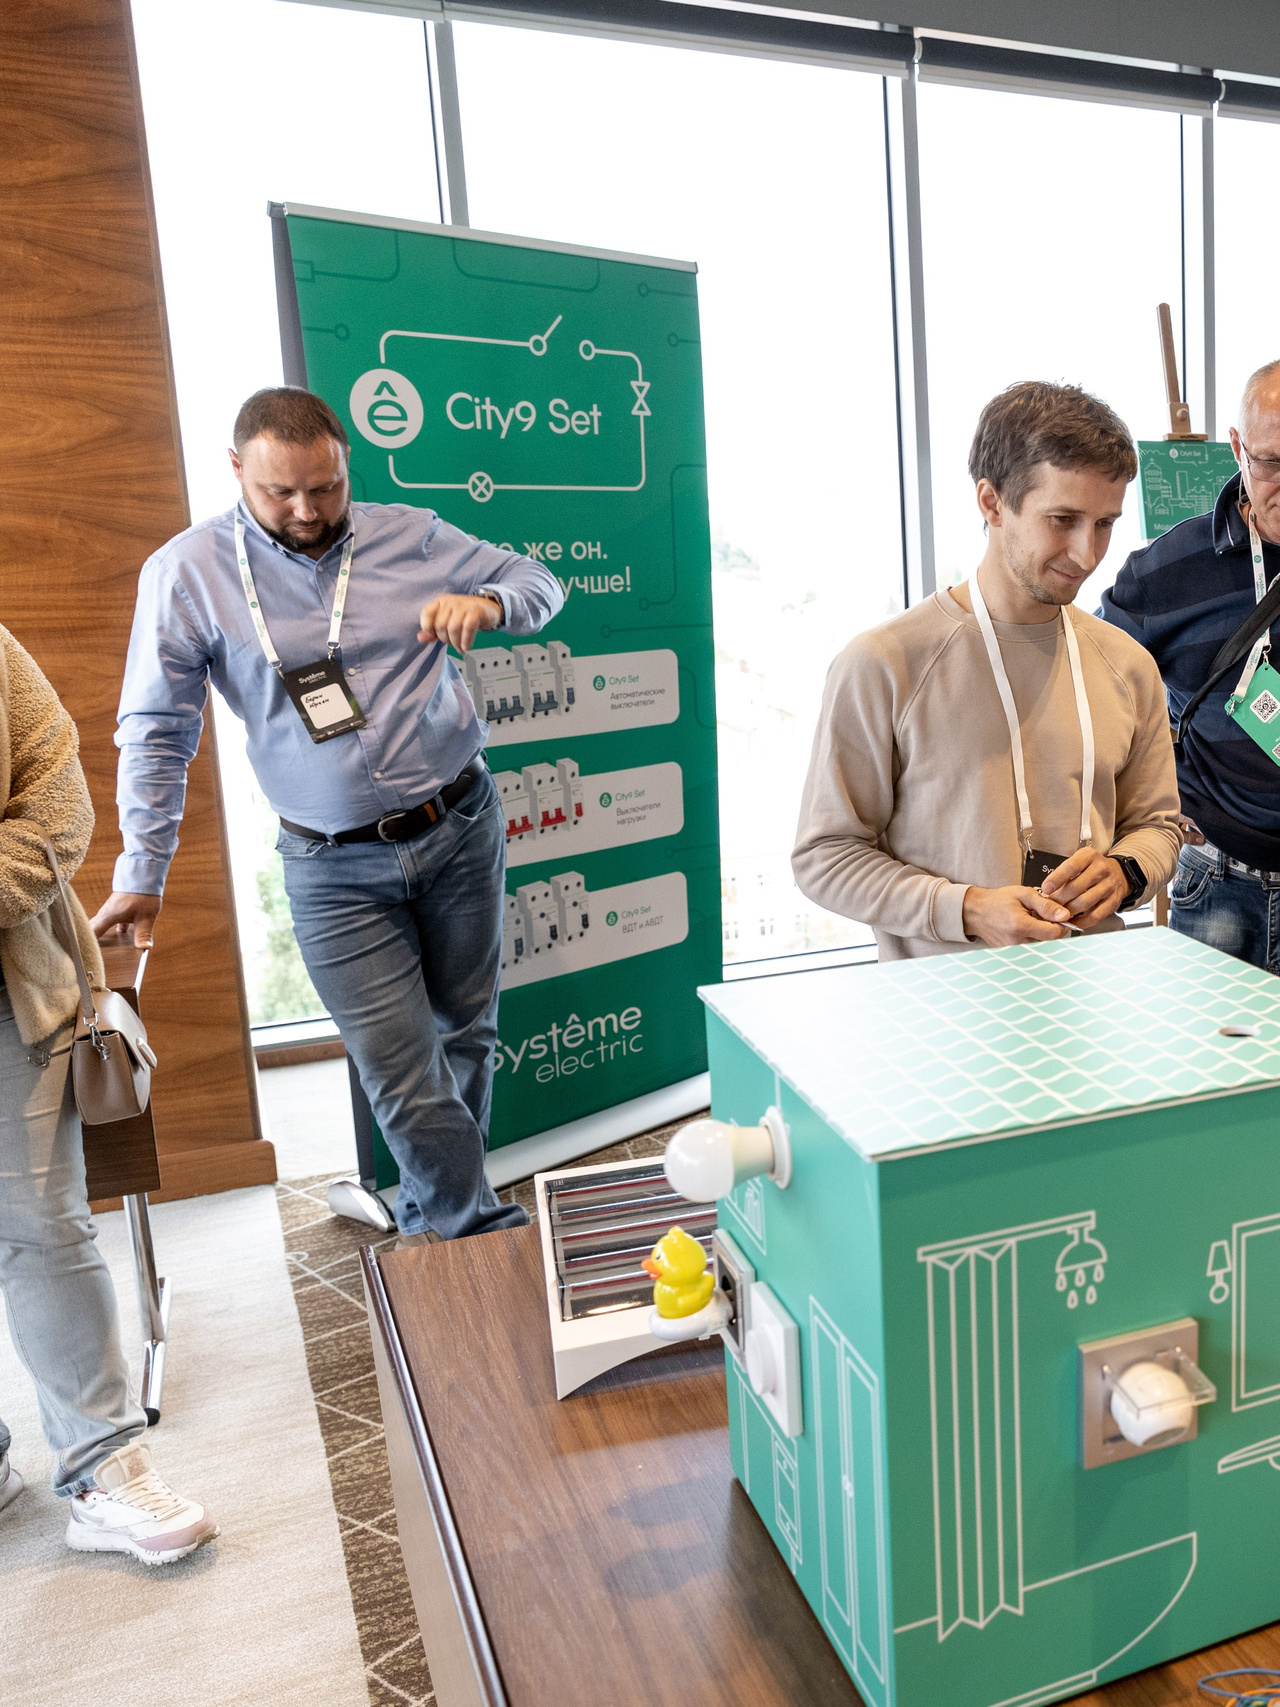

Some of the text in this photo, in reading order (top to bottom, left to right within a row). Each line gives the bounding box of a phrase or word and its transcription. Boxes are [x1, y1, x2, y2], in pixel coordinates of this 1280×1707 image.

[446, 392, 537, 439] City9
[548, 398, 602, 436] Set
[523, 541, 563, 561] же
[571, 540, 608, 561] он.
[557, 566, 632, 602] учше!
[609, 674, 639, 686] City9 Set
[610, 688, 666, 700] Автоматические
[610, 699, 655, 710] выключатели
[615, 789, 645, 801] City9 Set
[616, 802, 661, 816] Выключатели
[617, 815, 647, 825] нагрузки
[621, 906, 651, 919] City9 Set
[622, 922, 637, 934] ВДТ
[644, 915, 664, 928] АВДТ
[535, 1033, 644, 1083] electric
